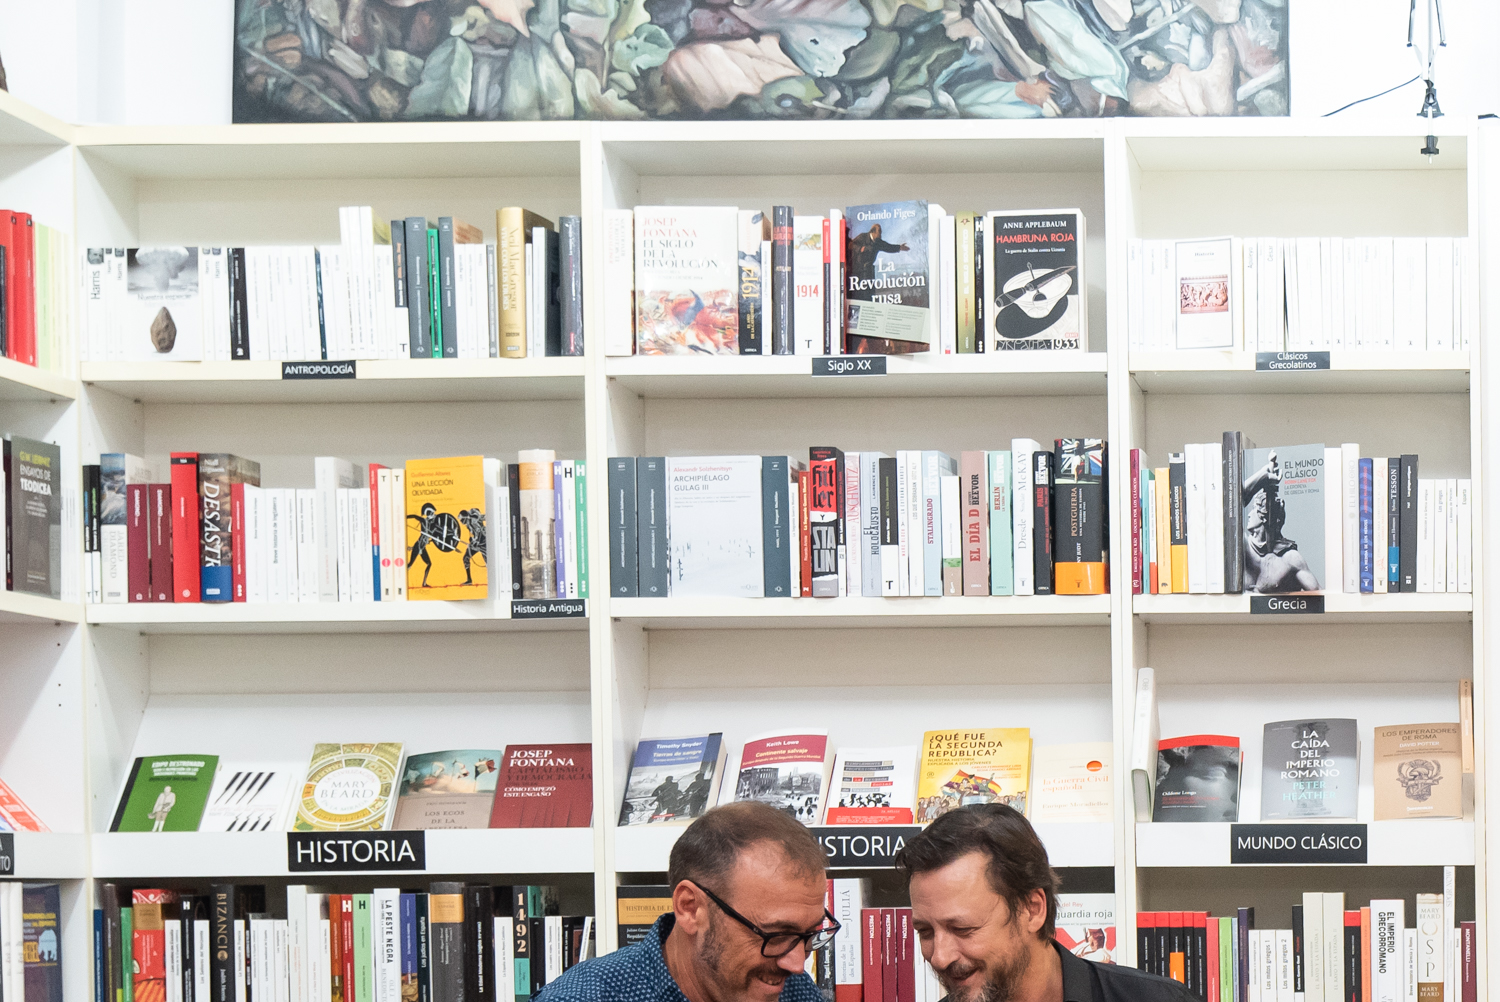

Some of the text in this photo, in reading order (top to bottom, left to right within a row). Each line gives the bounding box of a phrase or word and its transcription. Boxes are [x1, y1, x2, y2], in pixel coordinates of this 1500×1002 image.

[857, 209, 916, 222] Orlando Figes
[643, 218, 676, 226] JOSEP
[1025, 220, 1066, 229] APPLEBAUM
[643, 229, 697, 238] FONTANA
[996, 233, 1074, 244] HAMBRUNA ROJA
[643, 240, 693, 248] EL SIGLO
[878, 258, 895, 272] La
[91, 271, 100, 299] Harris
[742, 266, 759, 300] 1914
[849, 273, 925, 291] Revolución
[796, 285, 819, 298] 1914
[872, 291, 902, 304] rusa
[1277, 352, 1308, 361] Clásicos
[284, 362, 354, 377] ANTROPOLOGÍA
[827, 360, 872, 373] Siglo XX
[1269, 361, 1316, 369] Grecolatinos
[1285, 458, 1324, 469] EL MUNDO
[1285, 469, 1318, 479] CLÁSICO
[427, 479, 454, 487] LECCIÓN
[412, 488, 443, 496] OLVIDADA
[969, 509, 980, 562] EL DÍA D
[513, 603, 583, 615] Historia Antigua
[1268, 599, 1307, 610] Grecia
[930, 733, 959, 742] ¿QUÉ
[1303, 731, 1318, 739] LA
[1292, 739, 1330, 748] CAÍDA
[511, 750, 552, 758] JOSEP
[928, 748, 997, 757] REPÚBLICA?
[1286, 760, 1335, 769] IMPERIO
[1281, 769, 1340, 779] ROMANO
[1293, 781, 1326, 789] PETER
[321, 788, 374, 799] BEARD
[1283, 792, 1336, 801] HEATHER
[1238, 833, 1361, 849] MUNDO CLÁSICO
[297, 840, 415, 863] HISTORIA
[385, 900, 391, 910] LA
[1056, 910, 1112, 920] guardia roja
[516, 893, 527, 952] 1492
[1387, 912, 1395, 953] EL IMPERIO
